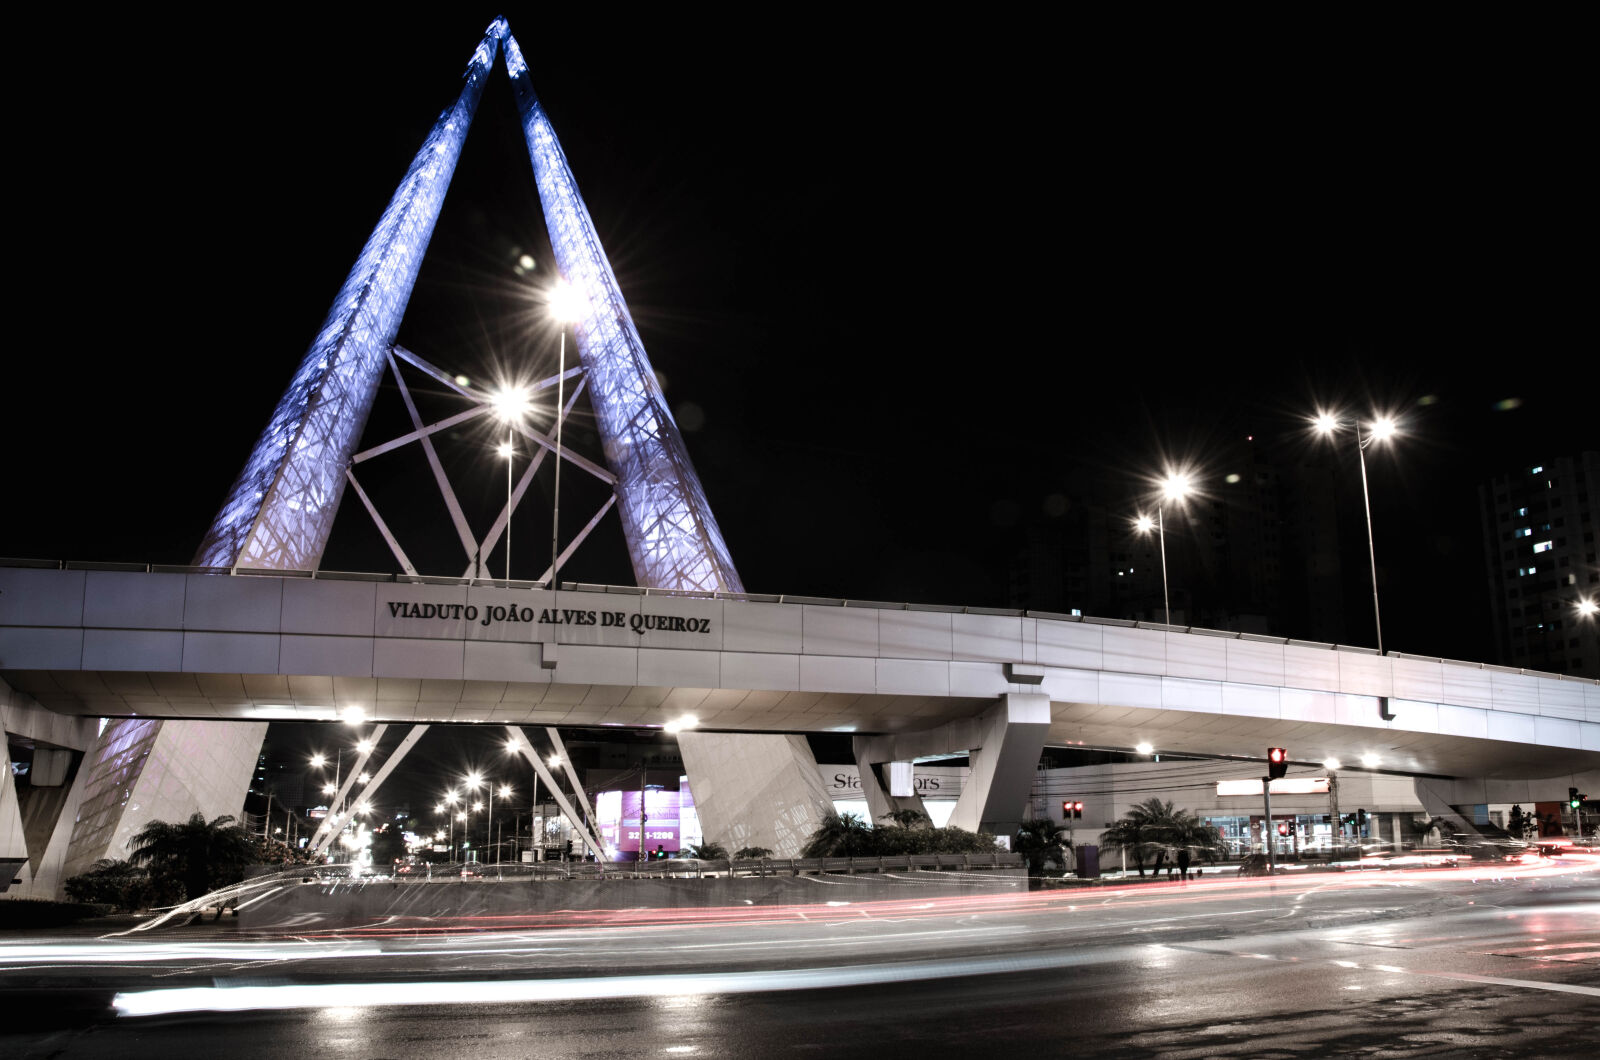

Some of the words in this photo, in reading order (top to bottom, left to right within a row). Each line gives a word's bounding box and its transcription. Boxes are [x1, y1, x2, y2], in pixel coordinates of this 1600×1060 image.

[388, 602, 478, 620] VIADUTO
[481, 603, 534, 626] JOÃO
[538, 608, 597, 626] ALVES
[601, 611, 626, 627] DE
[630, 613, 711, 635] QUEIROZ
[833, 773, 862, 789] Sta
[913, 777, 940, 790] ors
[628, 831, 674, 840] 321-1200
